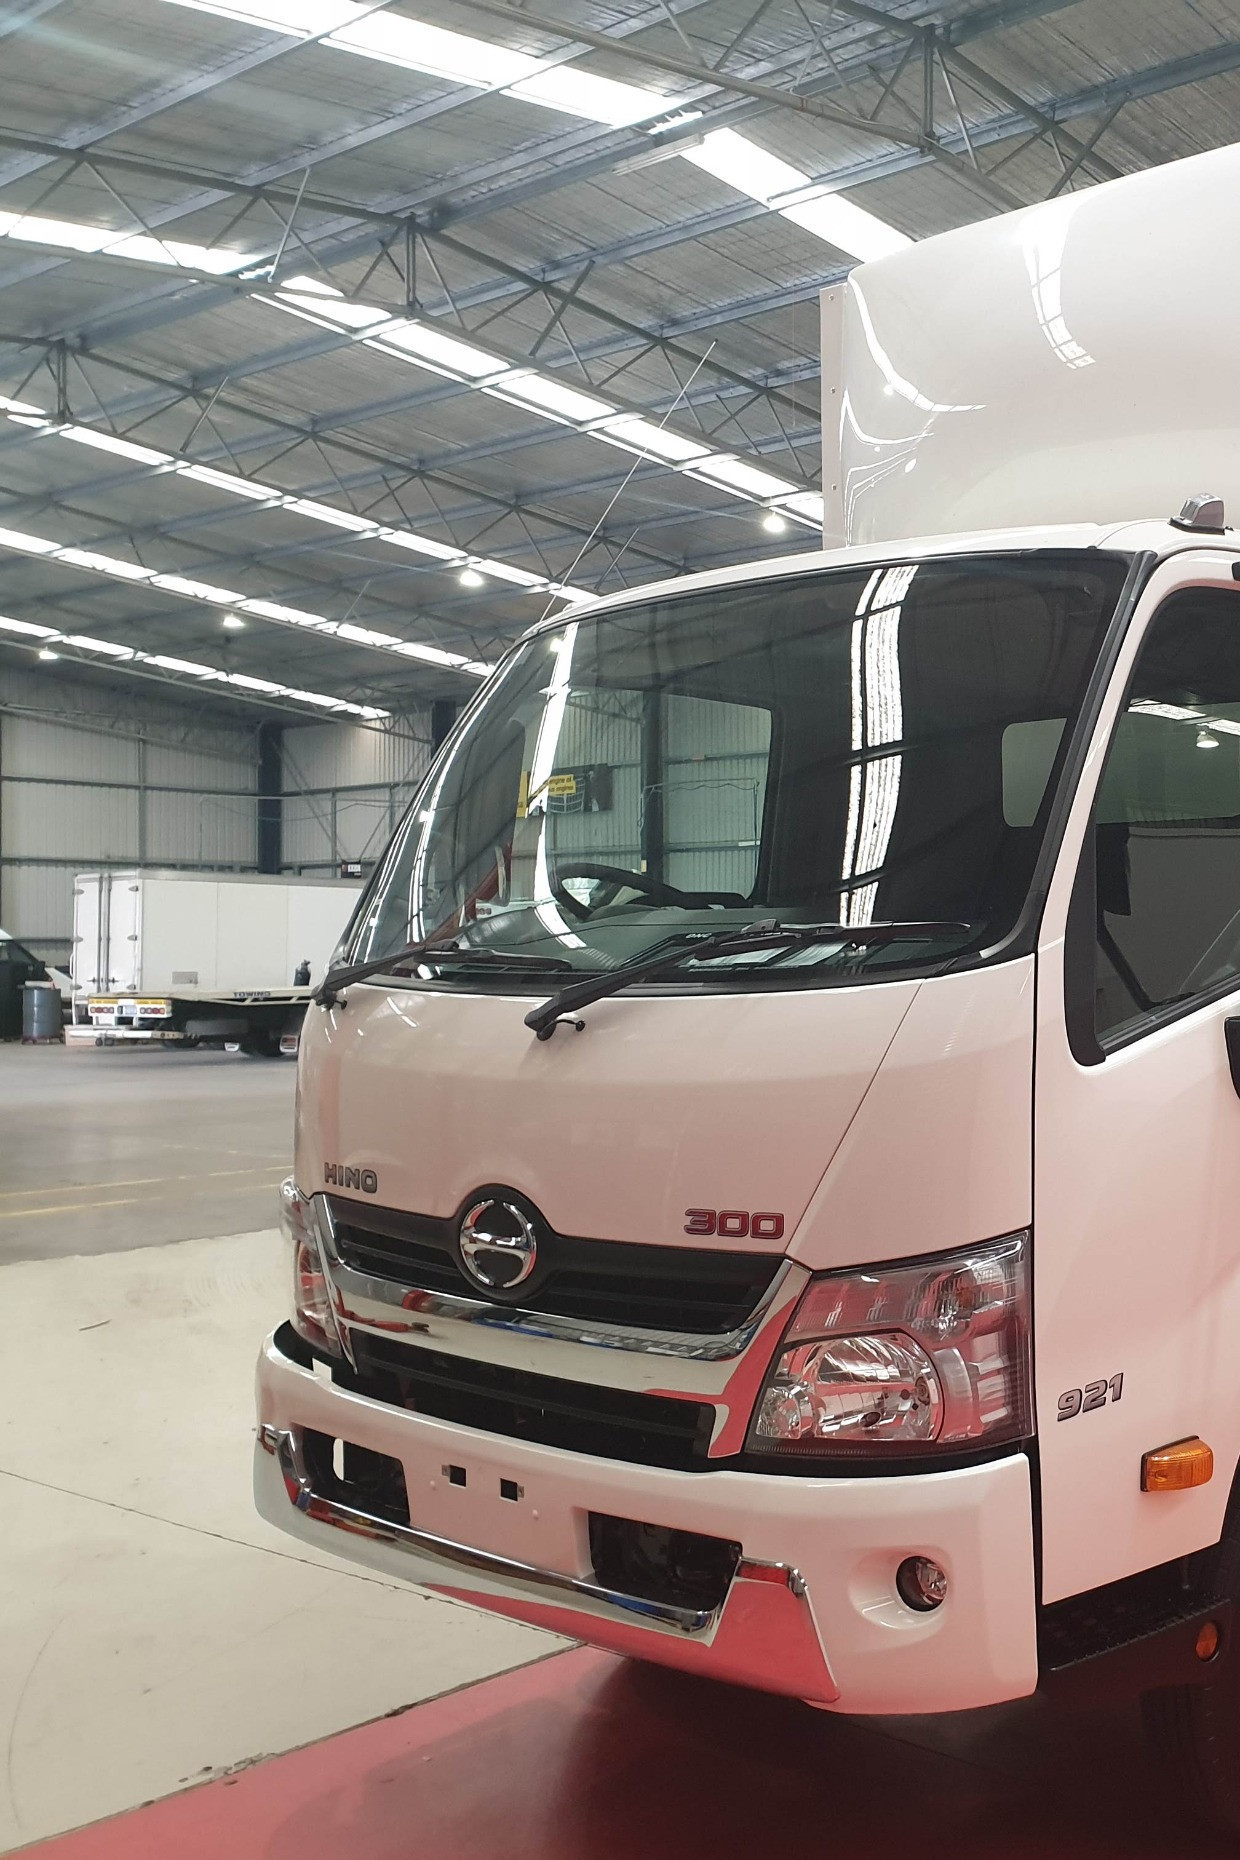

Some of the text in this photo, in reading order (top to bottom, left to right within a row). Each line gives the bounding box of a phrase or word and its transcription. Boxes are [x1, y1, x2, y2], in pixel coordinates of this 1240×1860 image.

[324, 1162, 378, 1194] HINO
[683, 1207, 785, 1240] 300
[1057, 1372, 1124, 1422] 921
